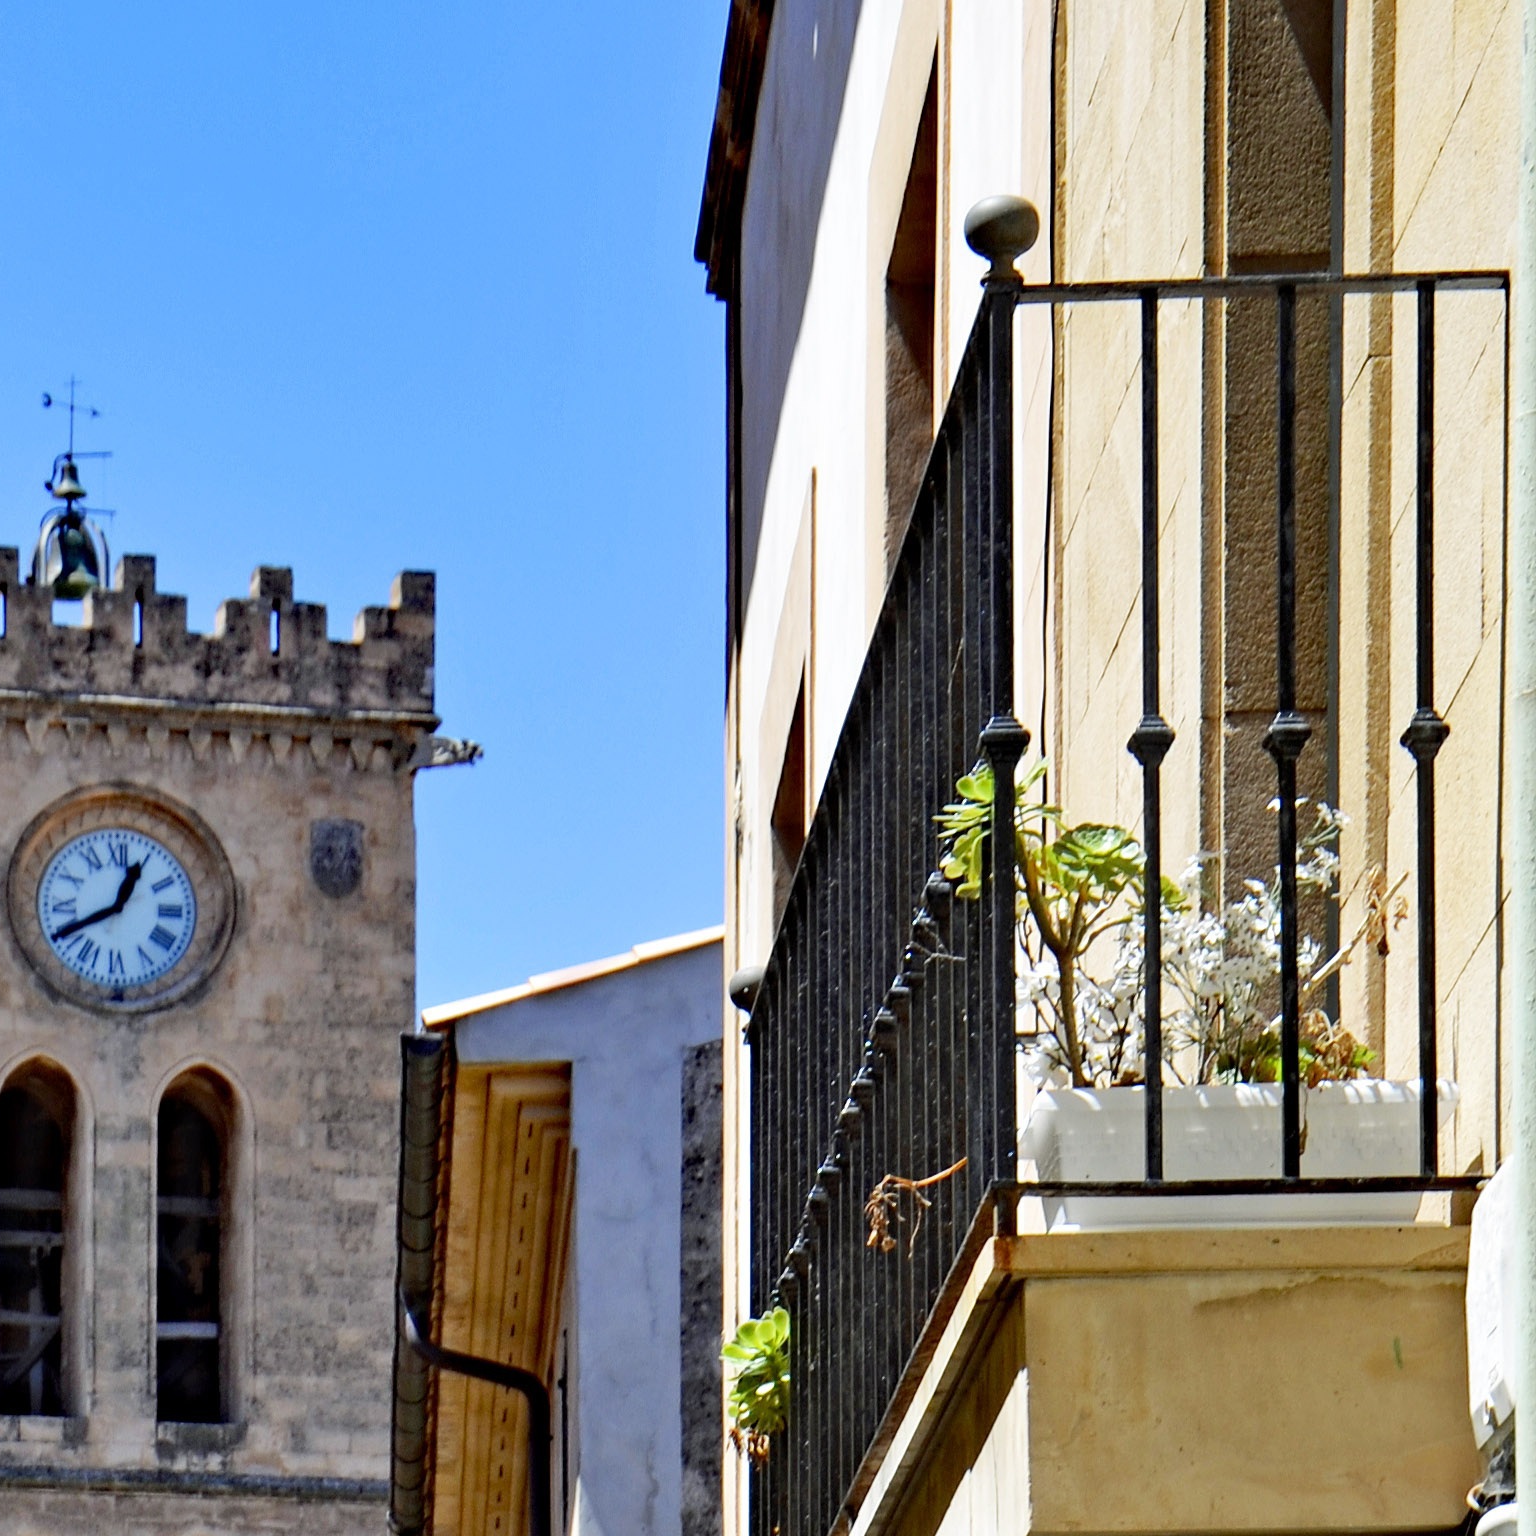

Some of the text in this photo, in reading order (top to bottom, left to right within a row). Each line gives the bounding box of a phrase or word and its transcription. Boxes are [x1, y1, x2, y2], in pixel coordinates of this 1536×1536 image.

[78, 846, 102, 875] XI
[107, 842, 128, 868] XII
[58, 866, 84, 890] X
[151, 875, 174, 893] II
[158, 904, 182, 918] III
[109, 949, 124, 974] VI
